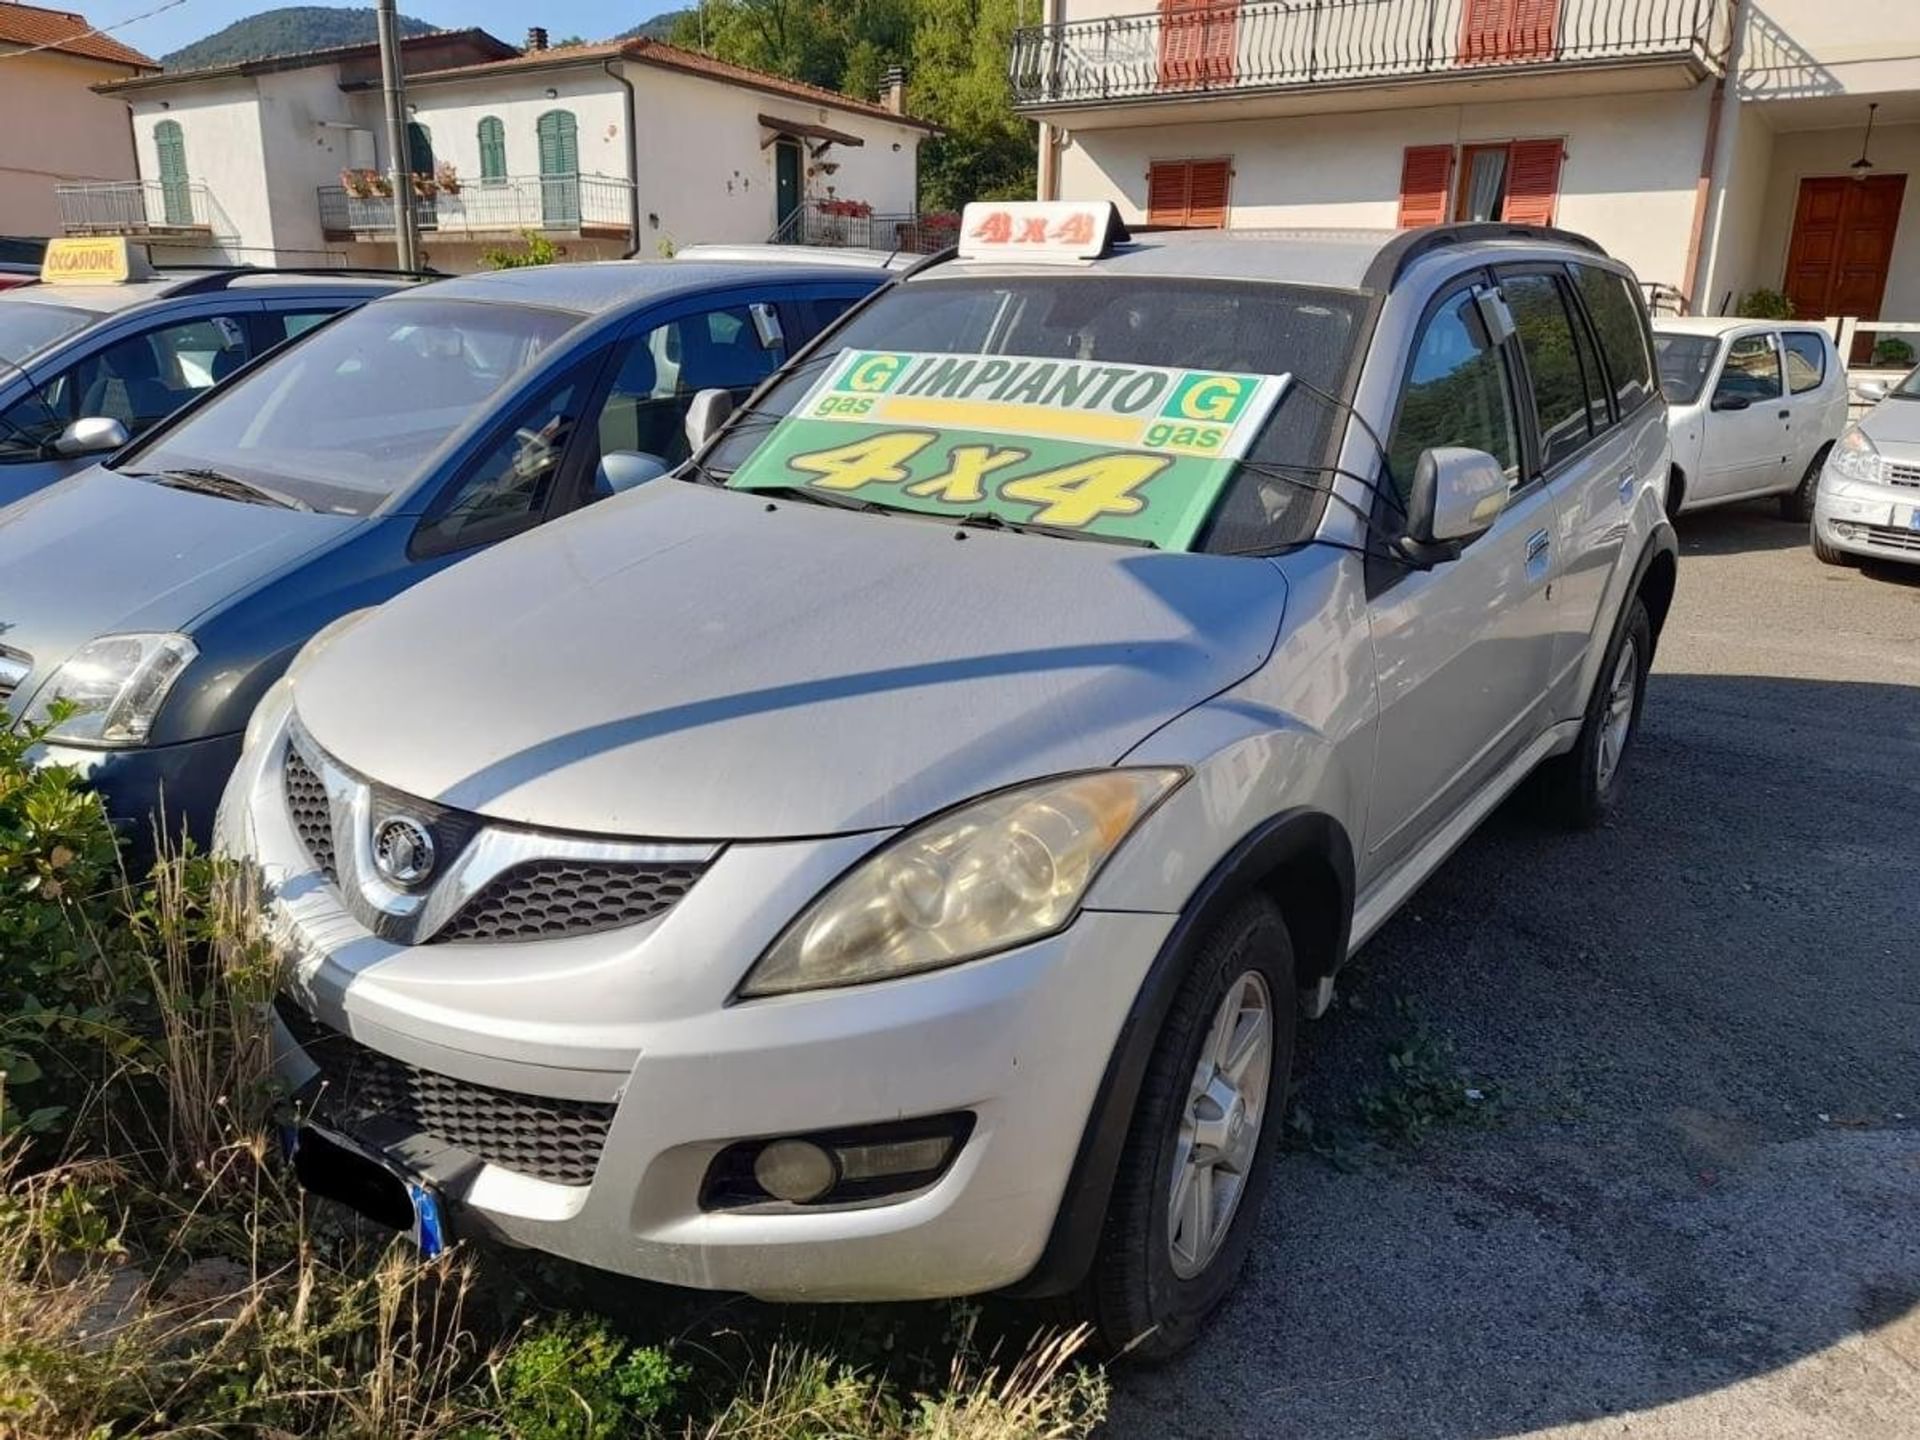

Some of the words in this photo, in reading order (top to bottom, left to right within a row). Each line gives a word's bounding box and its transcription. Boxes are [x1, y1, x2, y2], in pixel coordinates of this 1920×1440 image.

[49, 250, 115, 271] OCCASIONE
[852, 355, 901, 392] G
[903, 358, 1169, 415] IMPIANTO
[1180, 377, 1242, 421] G
[814, 395, 875, 418] gas
[1144, 421, 1223, 449] gas
